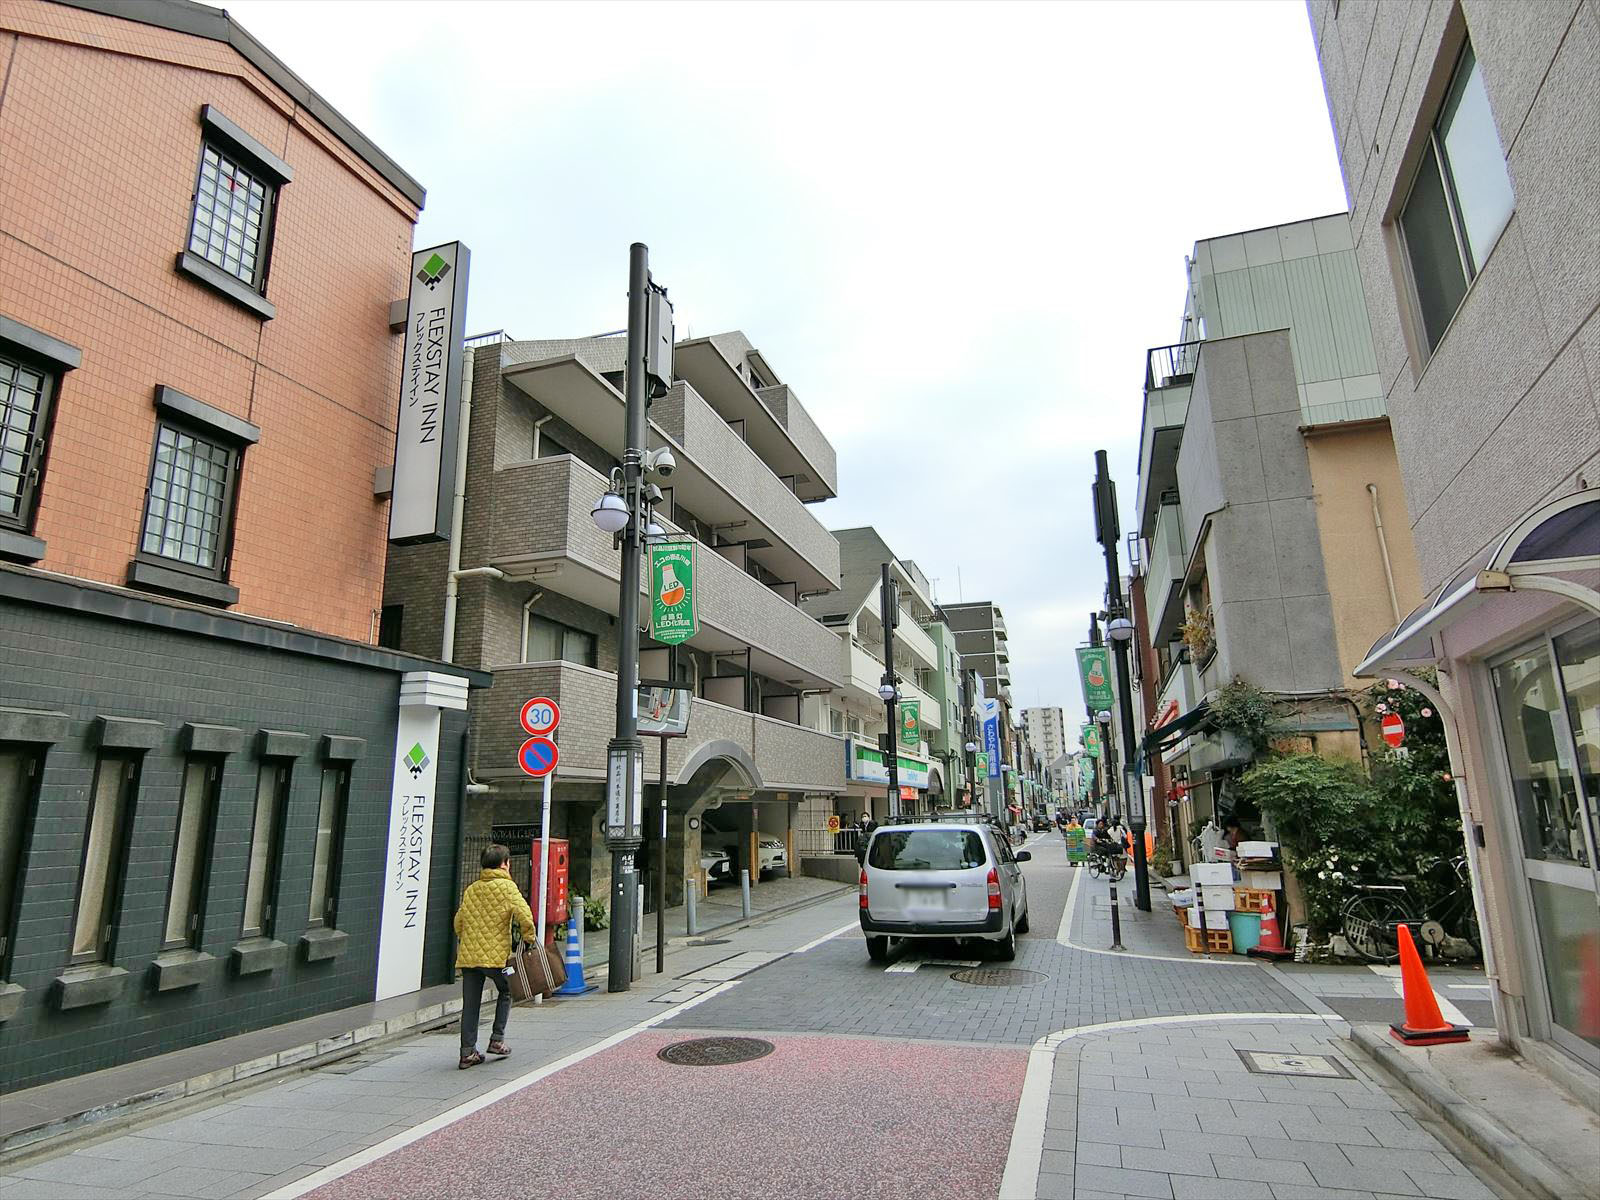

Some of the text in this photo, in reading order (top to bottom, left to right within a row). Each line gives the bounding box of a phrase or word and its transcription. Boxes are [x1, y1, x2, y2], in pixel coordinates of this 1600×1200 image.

[409, 312, 426, 408] フレックステイイン
[419, 307, 446, 444] FLEXSTAY INN
[663, 580, 680, 592] LED
[530, 708, 552, 725] 30
[395, 795, 410, 891] フレックステイイン
[403, 795, 426, 929] FLEXSTAY INN
